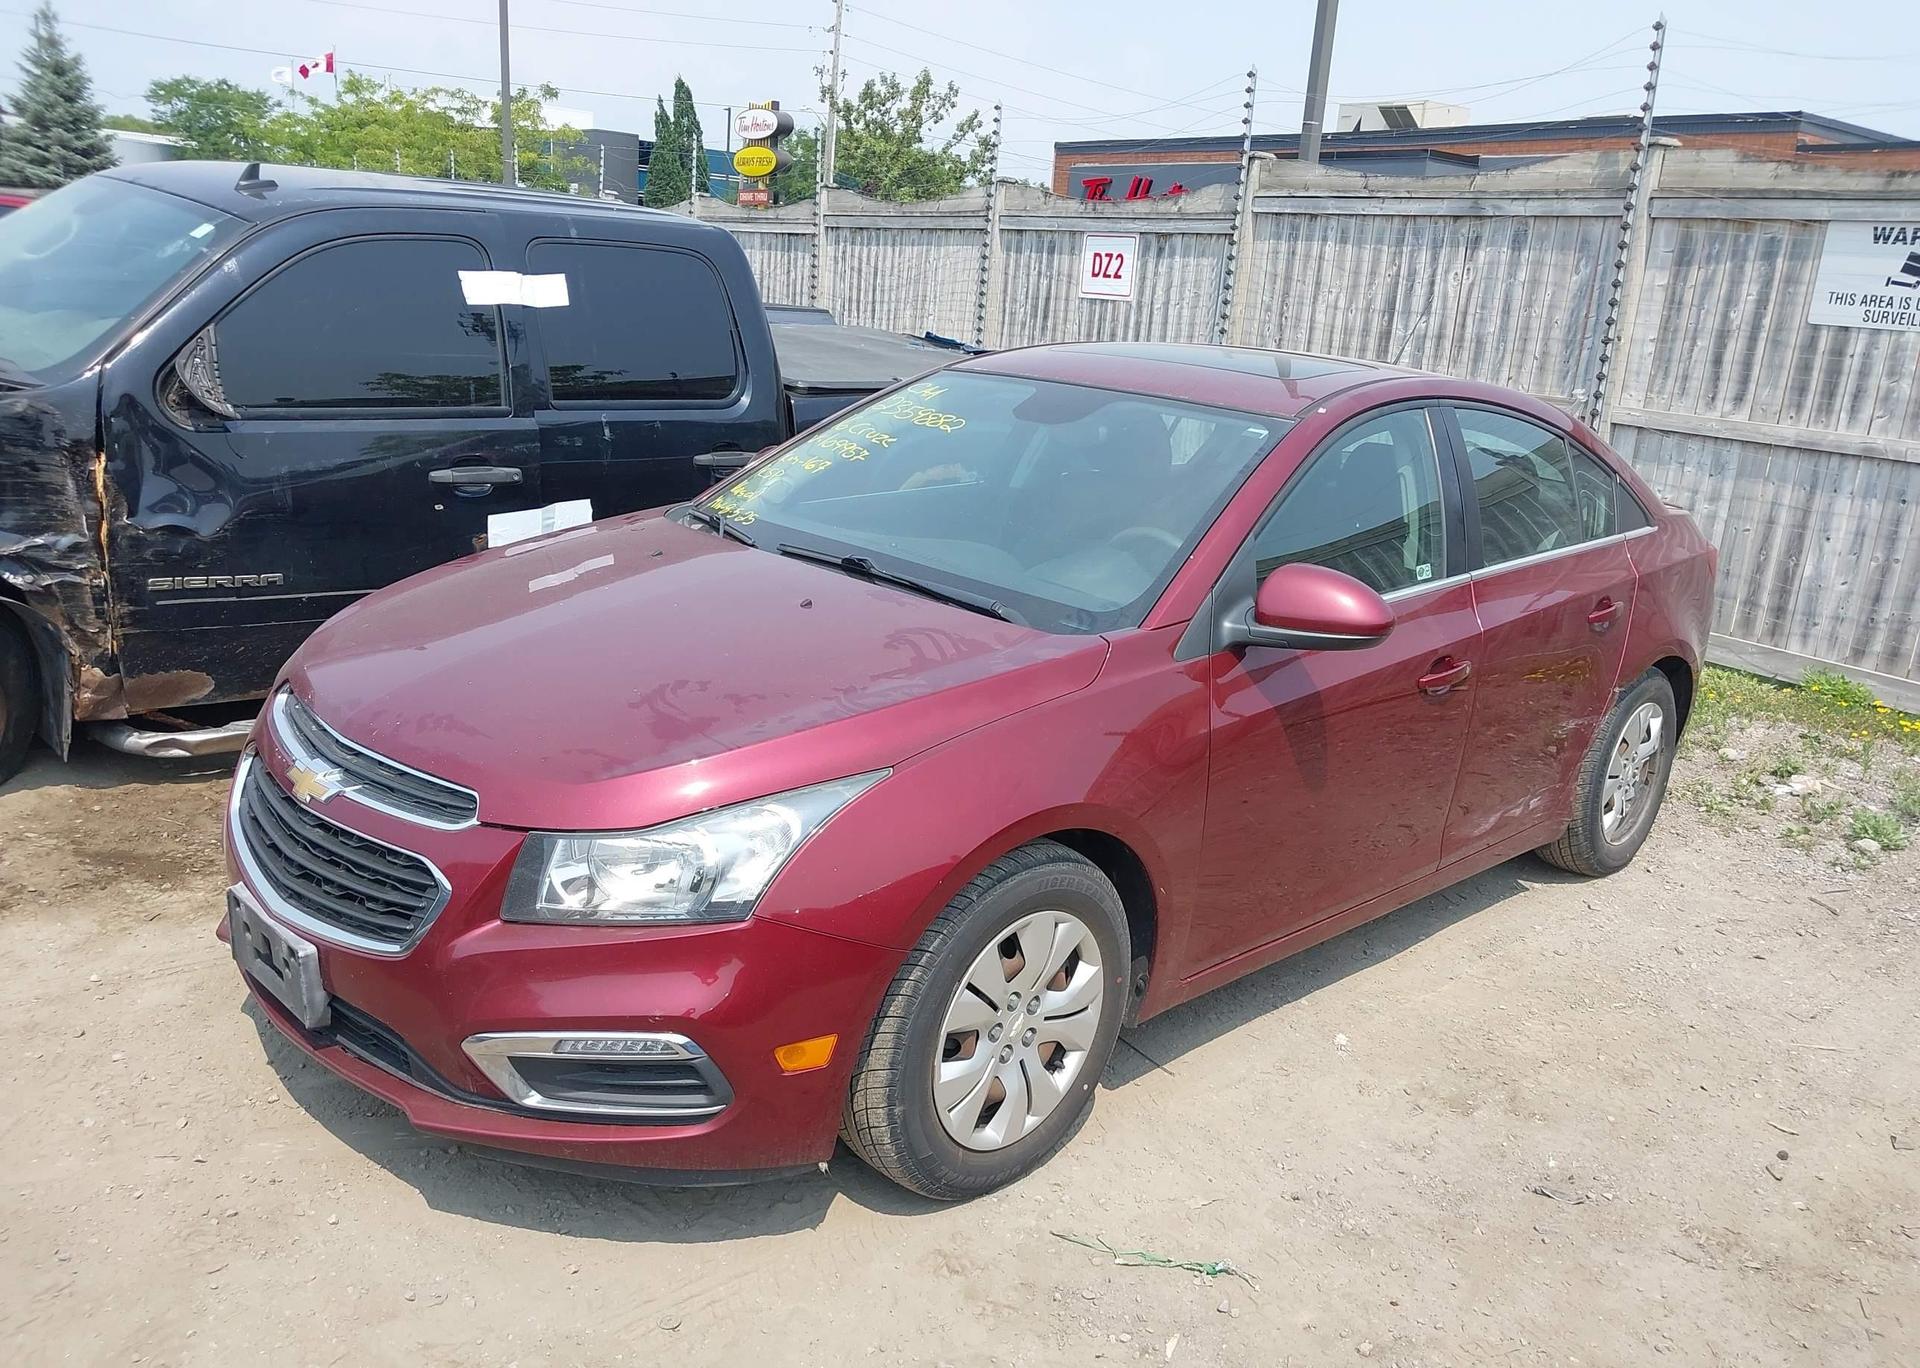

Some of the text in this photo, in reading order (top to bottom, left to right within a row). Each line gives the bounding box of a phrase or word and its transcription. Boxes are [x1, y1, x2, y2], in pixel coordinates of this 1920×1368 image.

[738, 115, 774, 133] Tim Hortons
[736, 156, 774, 166] ALWAYS FRESH
[739, 192, 768, 201] DRIVE THRU
[1091, 252, 1124, 279] DZ2
[1828, 291, 1857, 306] THIS
[1860, 294, 1894, 309] AREA
[1899, 296, 1912, 310] IS
[1862, 309, 1920, 327] SURVEIL
[148, 573, 284, 591] SIERRA
